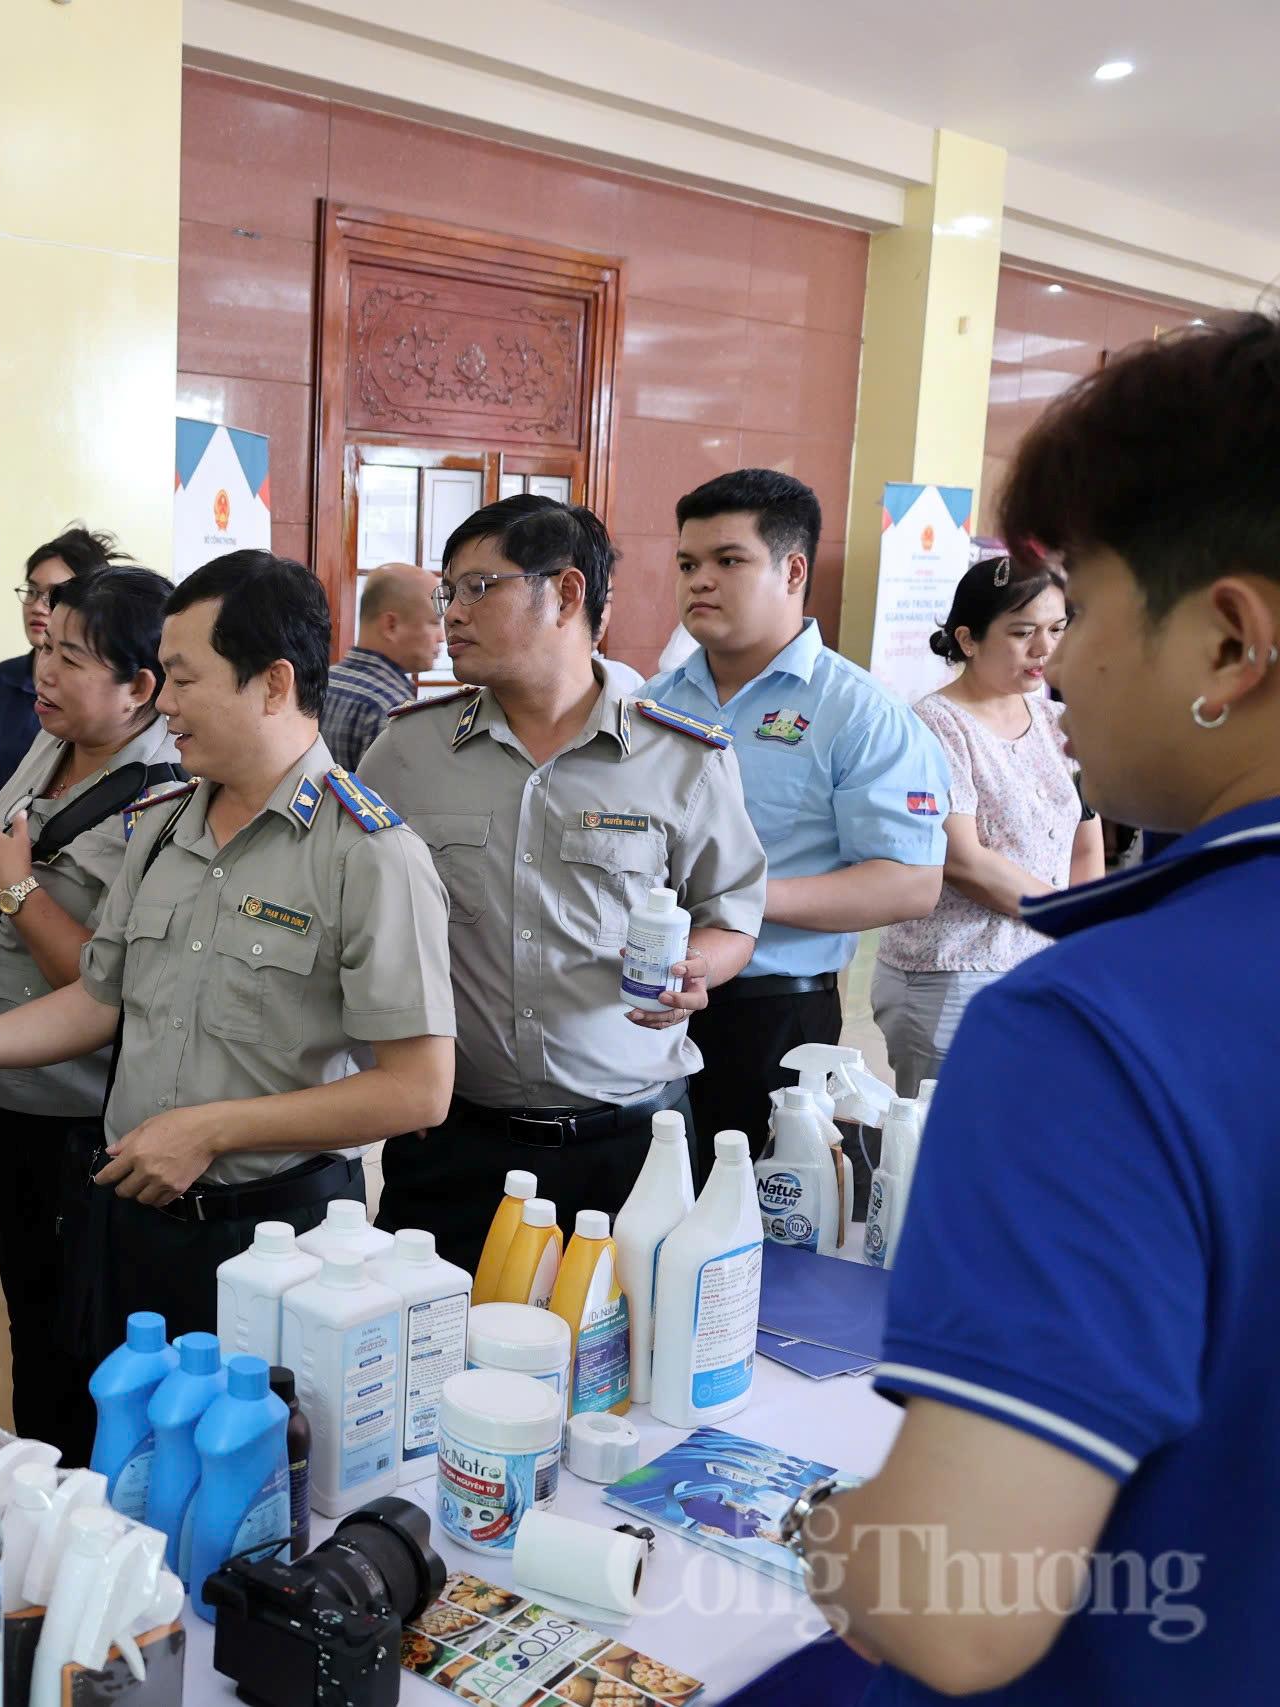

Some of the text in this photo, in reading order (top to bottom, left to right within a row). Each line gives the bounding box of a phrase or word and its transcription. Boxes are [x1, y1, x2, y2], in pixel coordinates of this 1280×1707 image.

[757, 1178, 802, 1199] Natus
[763, 1194, 797, 1207] CLEAN
[791, 1221, 805, 1234] 10X
[456, 1474, 485, 1492] NGUYÊN
